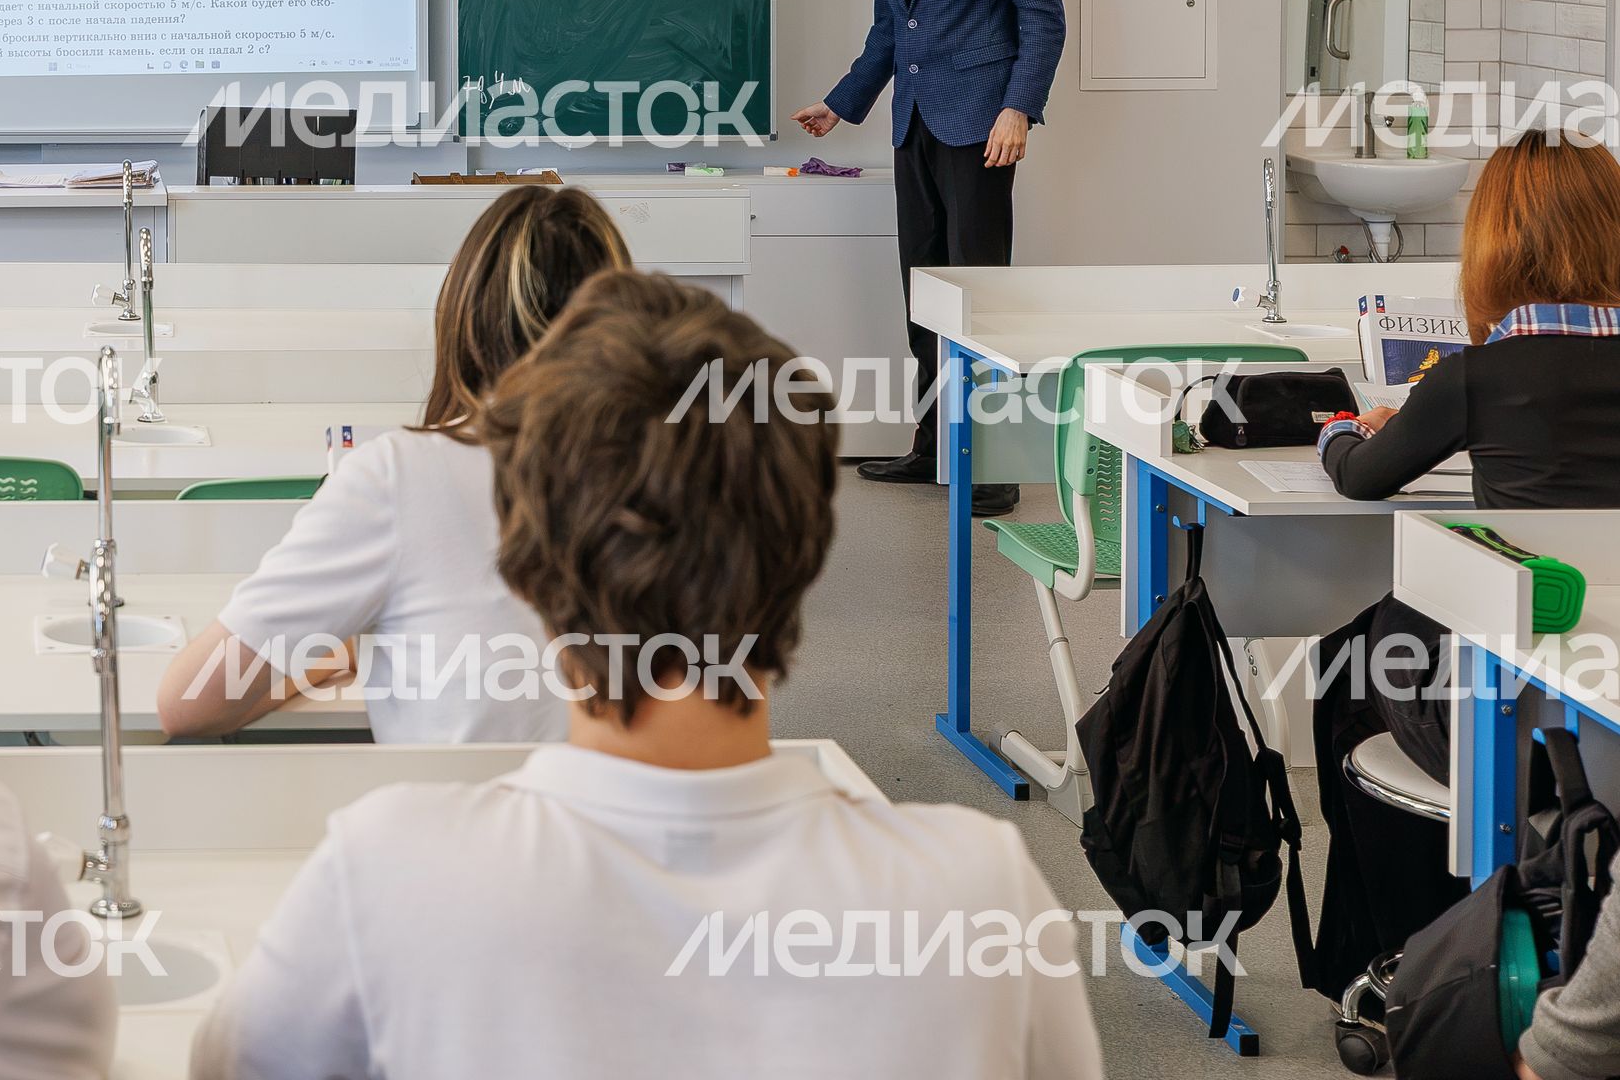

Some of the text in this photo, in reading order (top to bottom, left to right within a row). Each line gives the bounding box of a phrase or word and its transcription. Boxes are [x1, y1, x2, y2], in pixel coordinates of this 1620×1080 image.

[37, 0, 100, 11] начальной
[102, 1, 166, 12] скоростью
[287, 0, 306, 7] его
[48, 17, 81, 26] после
[83, 16, 126, 25] начала
[129, 13, 186, 27] падения?
[1, 31, 49, 45] бросили
[53, 32, 126, 45] вертикально
[129, 32, 157, 42] вниз
[169, 29, 231, 41] начальной
[234, 30, 296, 42] скоростью
[309, 27, 335, 41] м/с.
[1378, 315, 1470, 338] ФИЗИК
